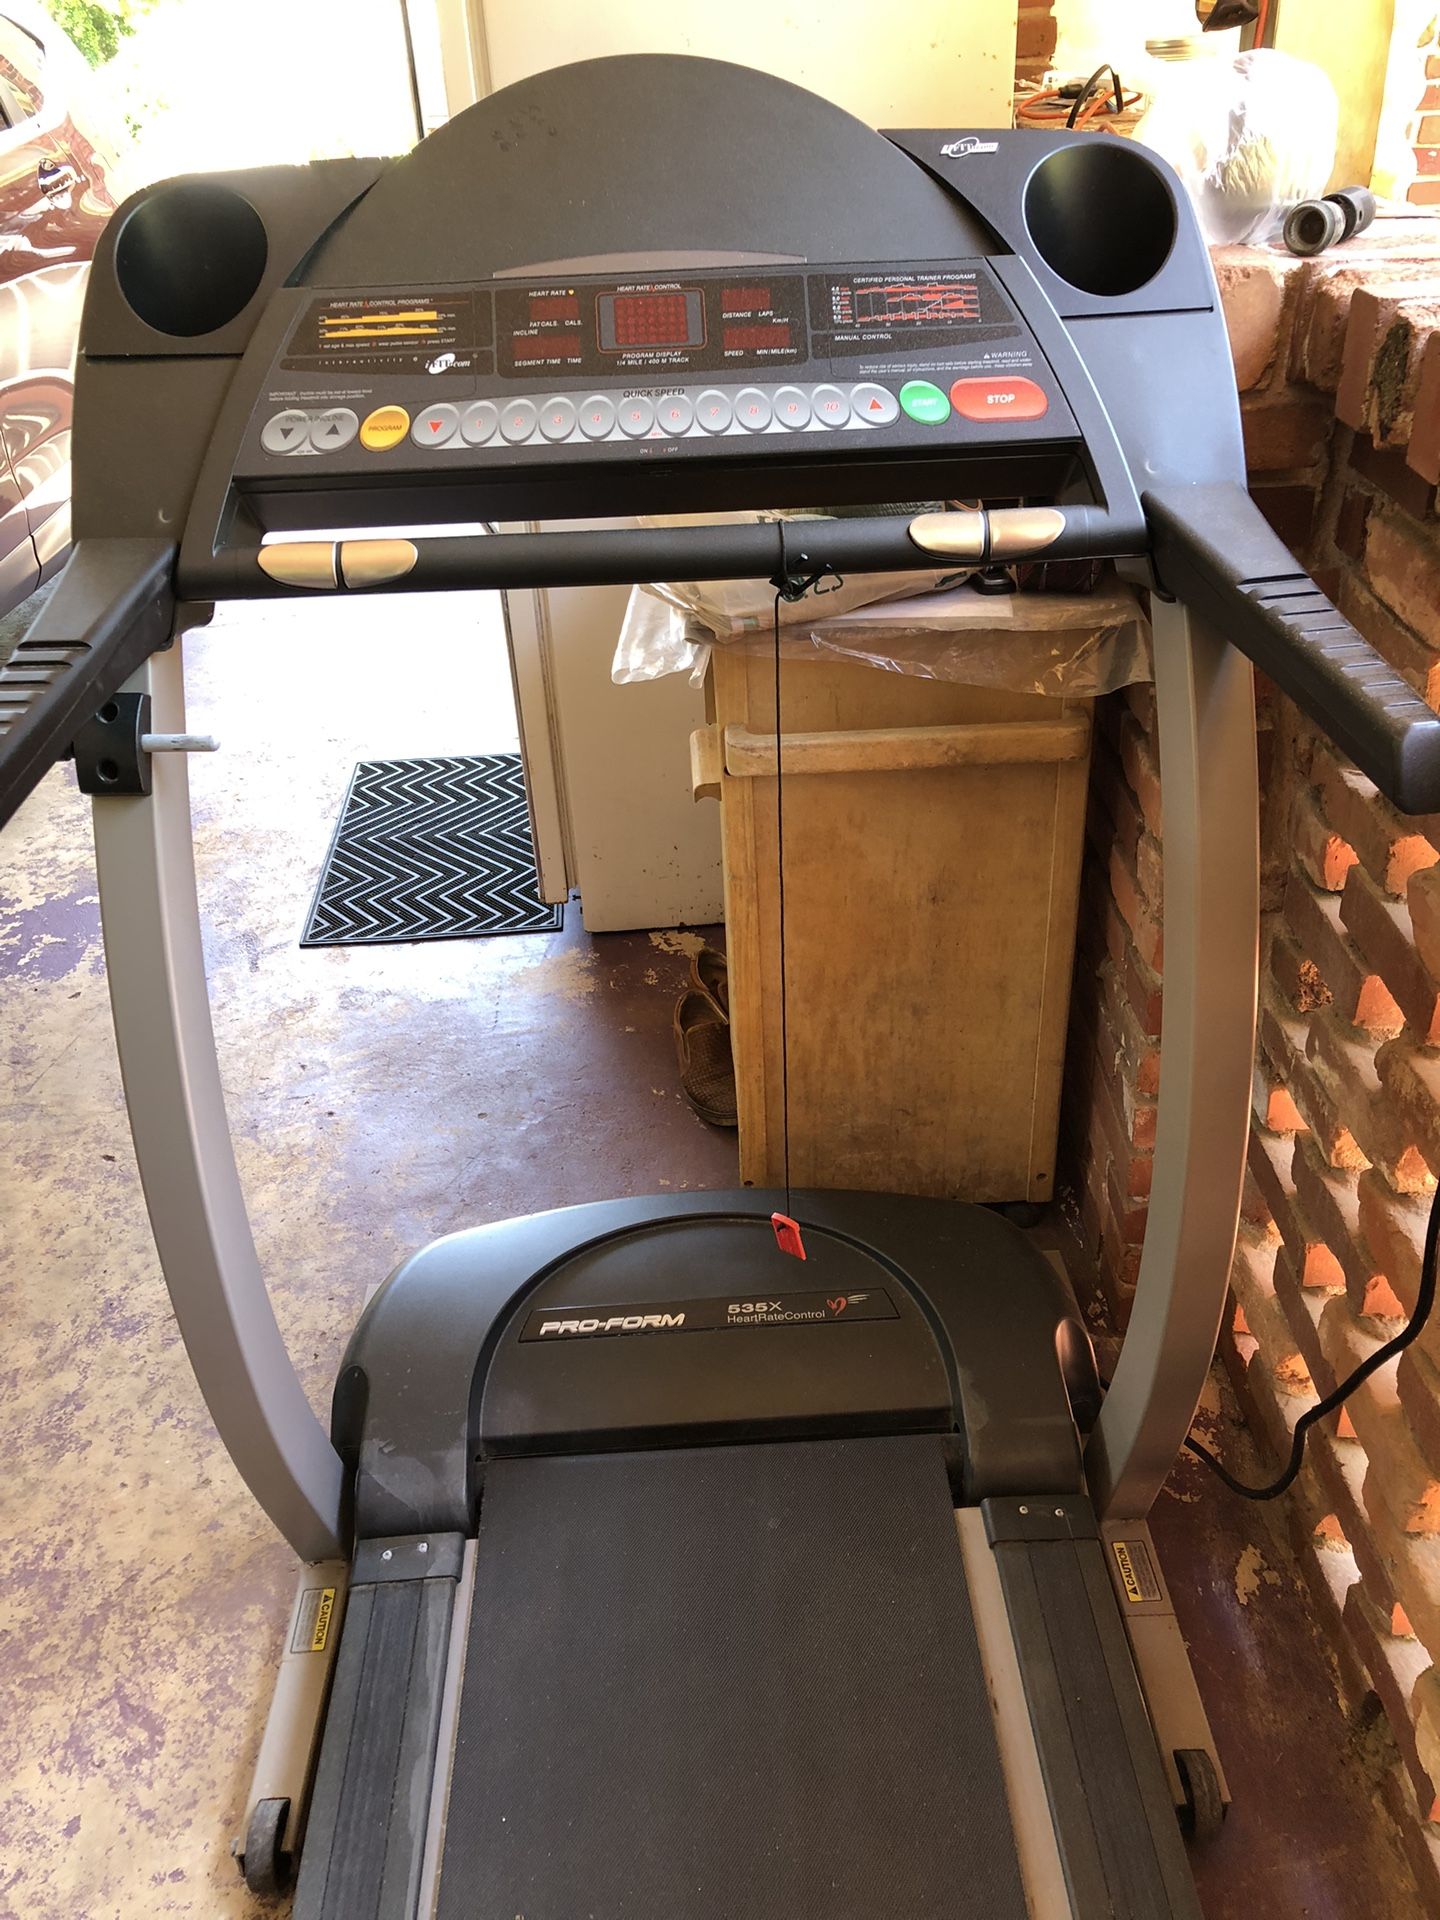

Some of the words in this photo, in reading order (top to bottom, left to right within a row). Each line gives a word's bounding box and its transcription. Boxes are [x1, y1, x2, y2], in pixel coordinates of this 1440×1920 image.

[991, 350, 1027, 358] WARNING
[514, 359, 544, 367] SEGMENT
[669, 356, 690, 364] TRACK
[623, 389, 653, 399] QUICK
[655, 387, 685, 397] SPEED
[911, 397, 939, 407] START
[986, 394, 1016, 405] STOP
[711, 406, 720, 416] 7
[749, 405, 759, 415] 8
[788, 403, 798, 413] 9
[824, 402, 839, 412] 10
[592, 413, 601, 423] 4
[631, 410, 641, 421] 5
[671, 408, 680, 419] 6
[553, 415, 563, 425] 3
[368, 424, 403, 432] PROGRAM
[727, 1301, 783, 1314] 535X
[727, 1310, 825, 1324] HeartRateControl
[540, 1313, 685, 1336] PRO-FORM
[1116, 1547, 1136, 1586] CAUTION
[314, 1604, 330, 1645] CAUTION
